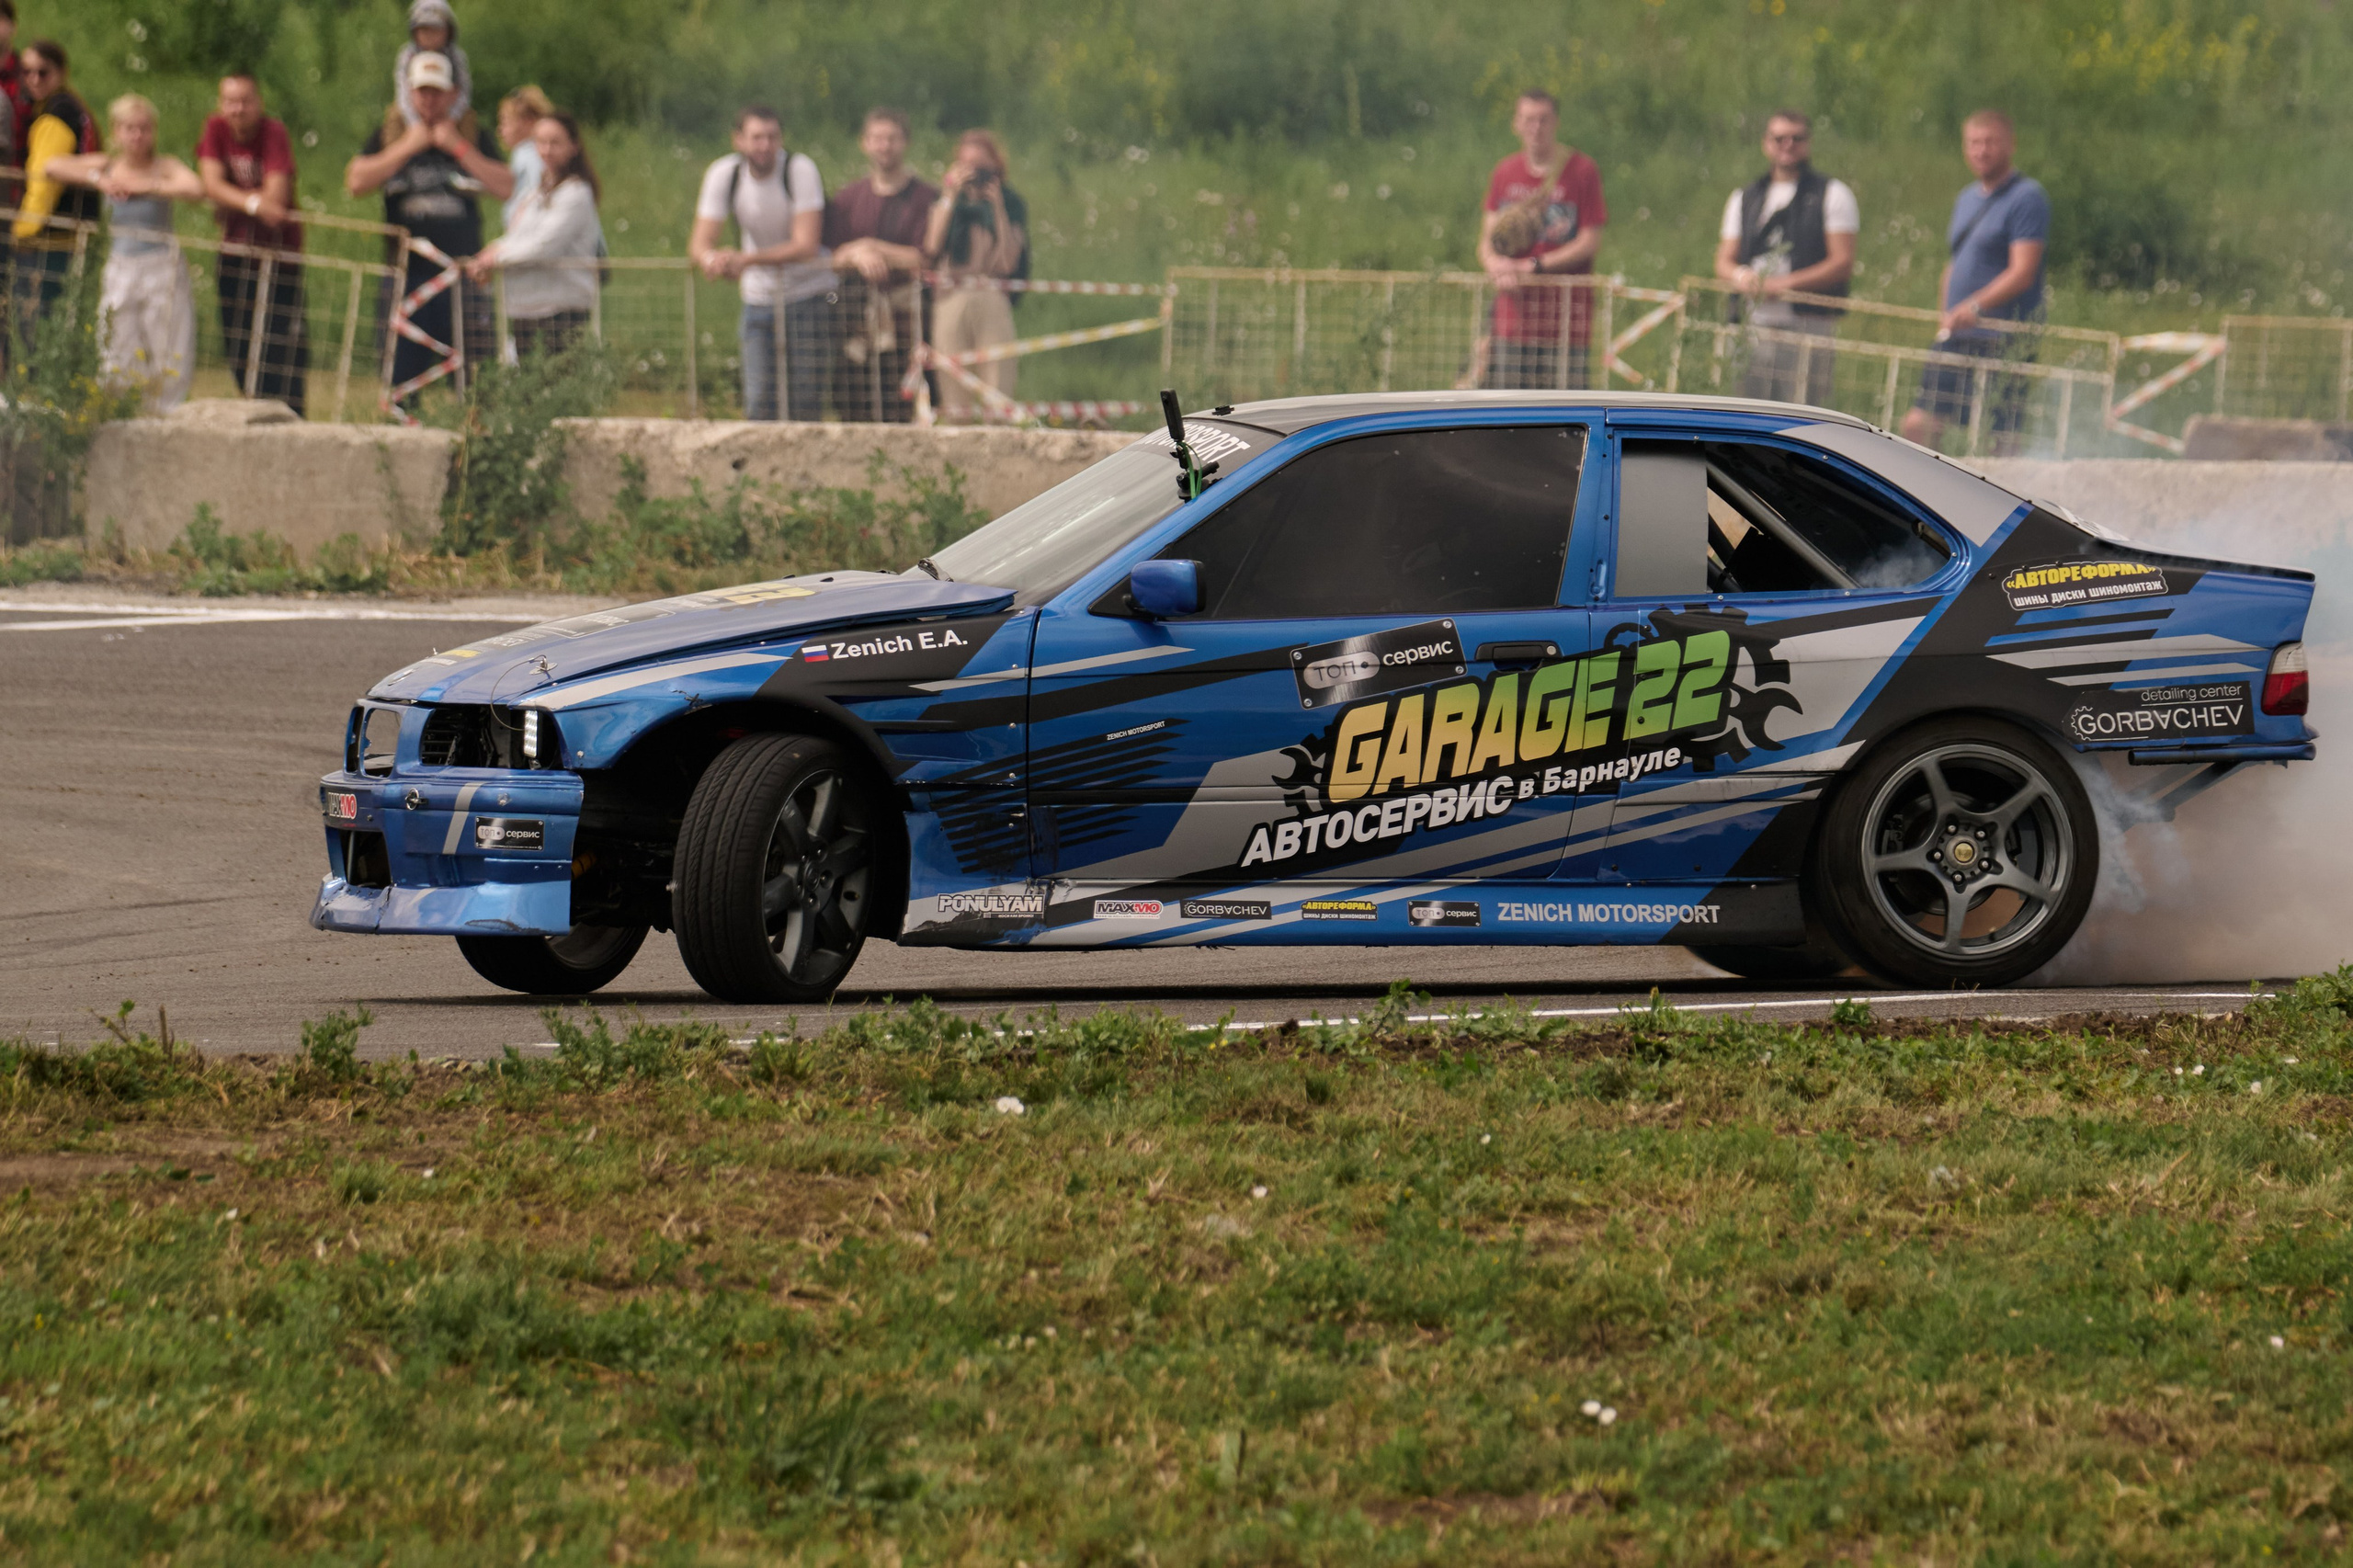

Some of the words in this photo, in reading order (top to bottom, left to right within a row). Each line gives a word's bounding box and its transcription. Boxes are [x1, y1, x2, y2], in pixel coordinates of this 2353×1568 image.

[2006, 562, 2156, 589] «АВТОРЕФОРМА»
[830, 635, 913, 659] Zenich
[918, 630, 968, 650] E.A.
[1382, 641, 1454, 666] сервис
[2141, 687, 2197, 702] detailing
[2200, 685, 2243, 699] center
[1328, 651, 1620, 803] GARAGE
[1622, 630, 1731, 742] 22
[1106, 731, 1128, 741] ZENICH
[1127, 721, 1165, 736] MOTORSPORT
[1241, 776, 1517, 869] АВТОСЕРВИС
[1518, 779, 1535, 799] в
[1544, 746, 1681, 794] Барнауле
[506, 830, 540, 838] сервис
[938, 894, 1043, 912] PONULYAM
[1497, 903, 1573, 922] ZENICH
[1578, 903, 1721, 924] MOTORSPORT
